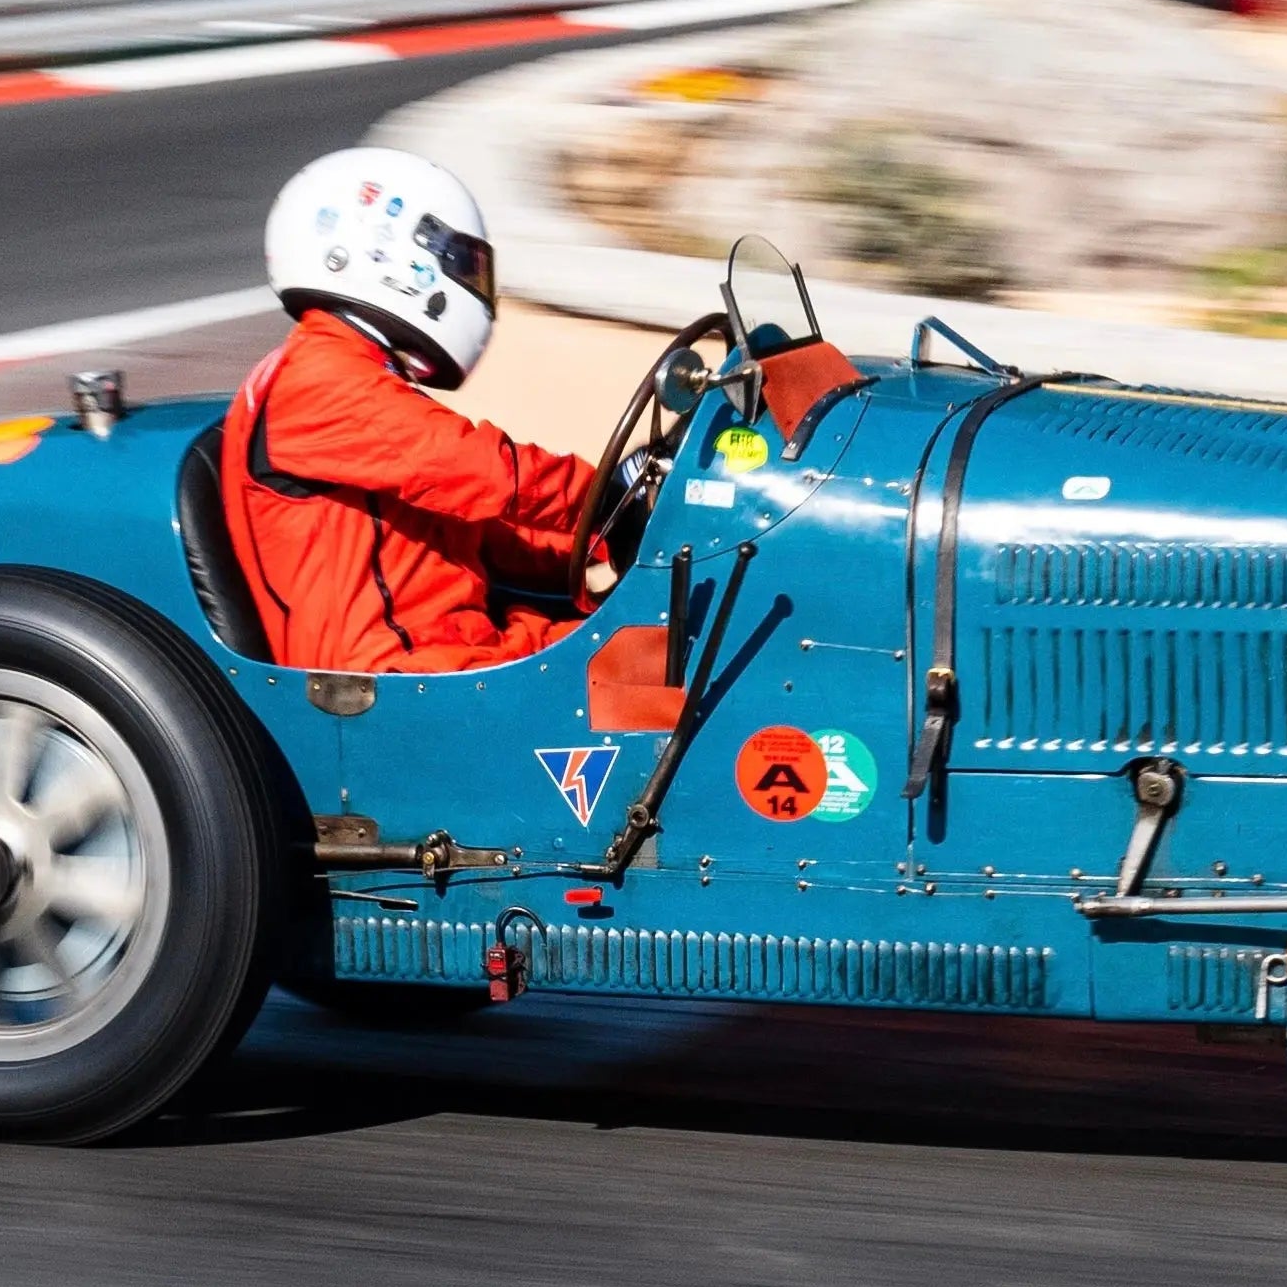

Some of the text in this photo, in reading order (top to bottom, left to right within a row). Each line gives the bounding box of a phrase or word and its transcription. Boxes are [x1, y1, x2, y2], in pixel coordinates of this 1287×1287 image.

[817, 735, 846, 754] 12
[753, 763, 810, 793] A
[825, 761, 870, 792] A
[767, 795, 798, 815] 14
